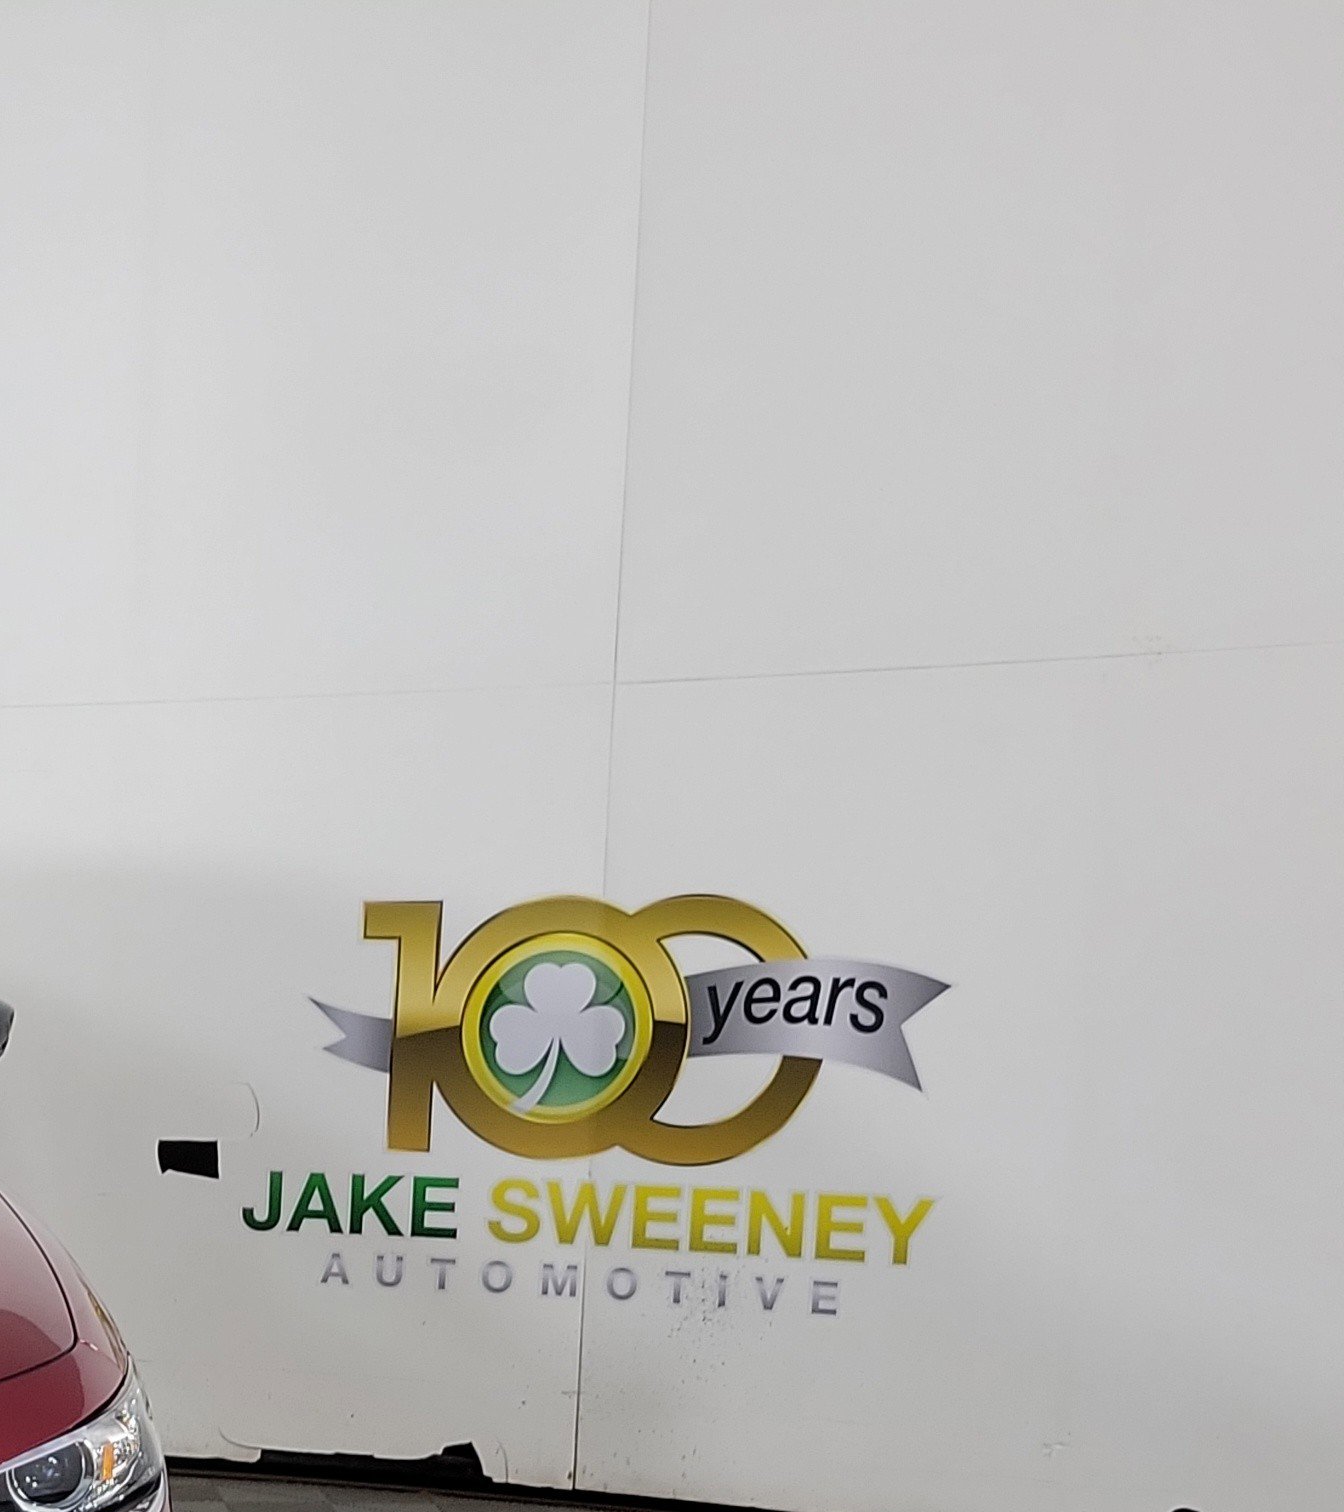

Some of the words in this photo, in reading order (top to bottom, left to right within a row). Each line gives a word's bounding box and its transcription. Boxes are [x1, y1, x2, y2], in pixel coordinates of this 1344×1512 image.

[362, 894, 824, 1166] 100
[702, 974, 889, 1045] years
[242, 1171, 460, 1240] JAKE
[487, 1180, 934, 1266] SWEENEY
[321, 1253, 839, 1317] AUTOMOTIVE
